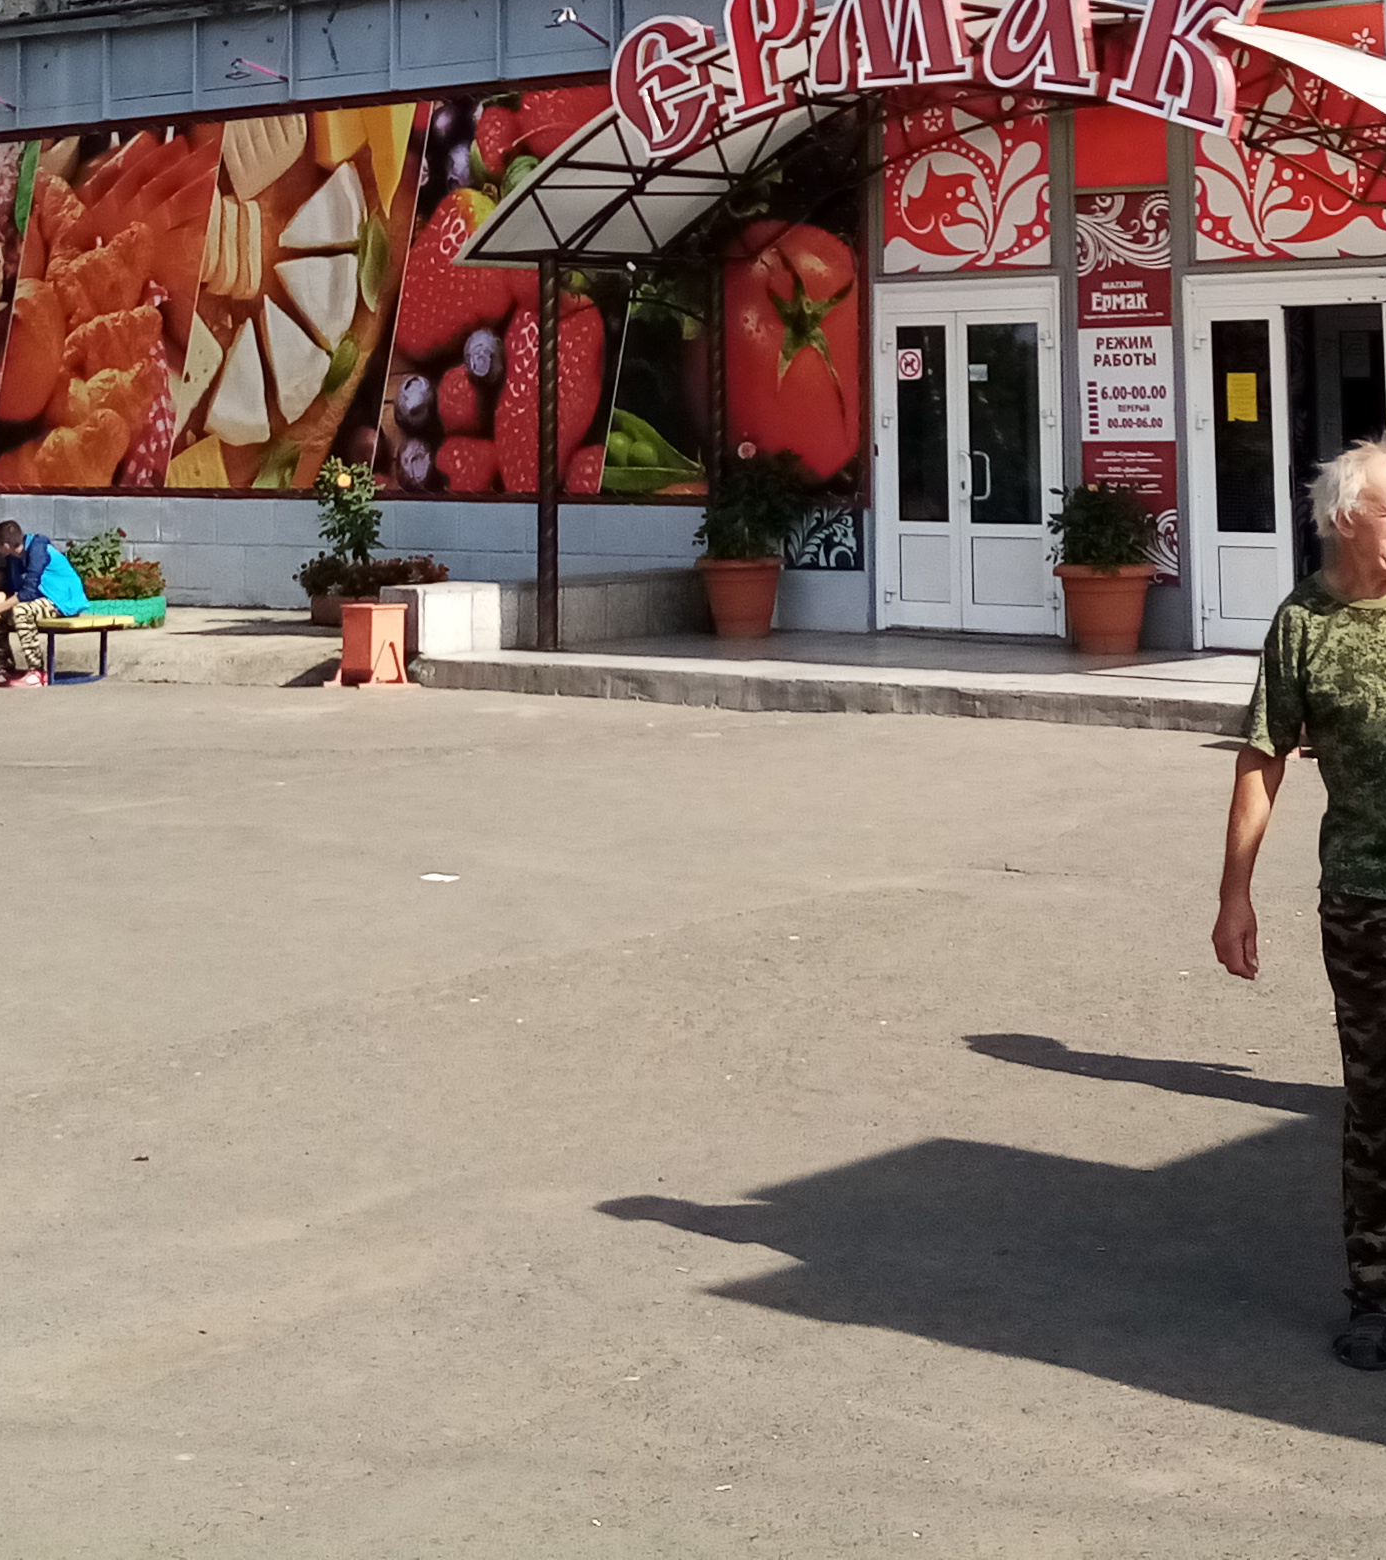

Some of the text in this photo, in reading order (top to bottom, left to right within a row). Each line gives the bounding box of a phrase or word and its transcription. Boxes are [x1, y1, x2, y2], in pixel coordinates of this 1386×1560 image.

[1091, 291, 1149, 312] Ермак
[1096, 336, 1153, 350] РЕЖИМ
[1093, 352, 1157, 367] РАБОТЫ
[1101, 385, 1167, 400] 6.00-00.00
[1117, 404, 1151, 412] ПЕРЕРЫВ
[1107, 417, 1163, 428] 00.00-06.00
